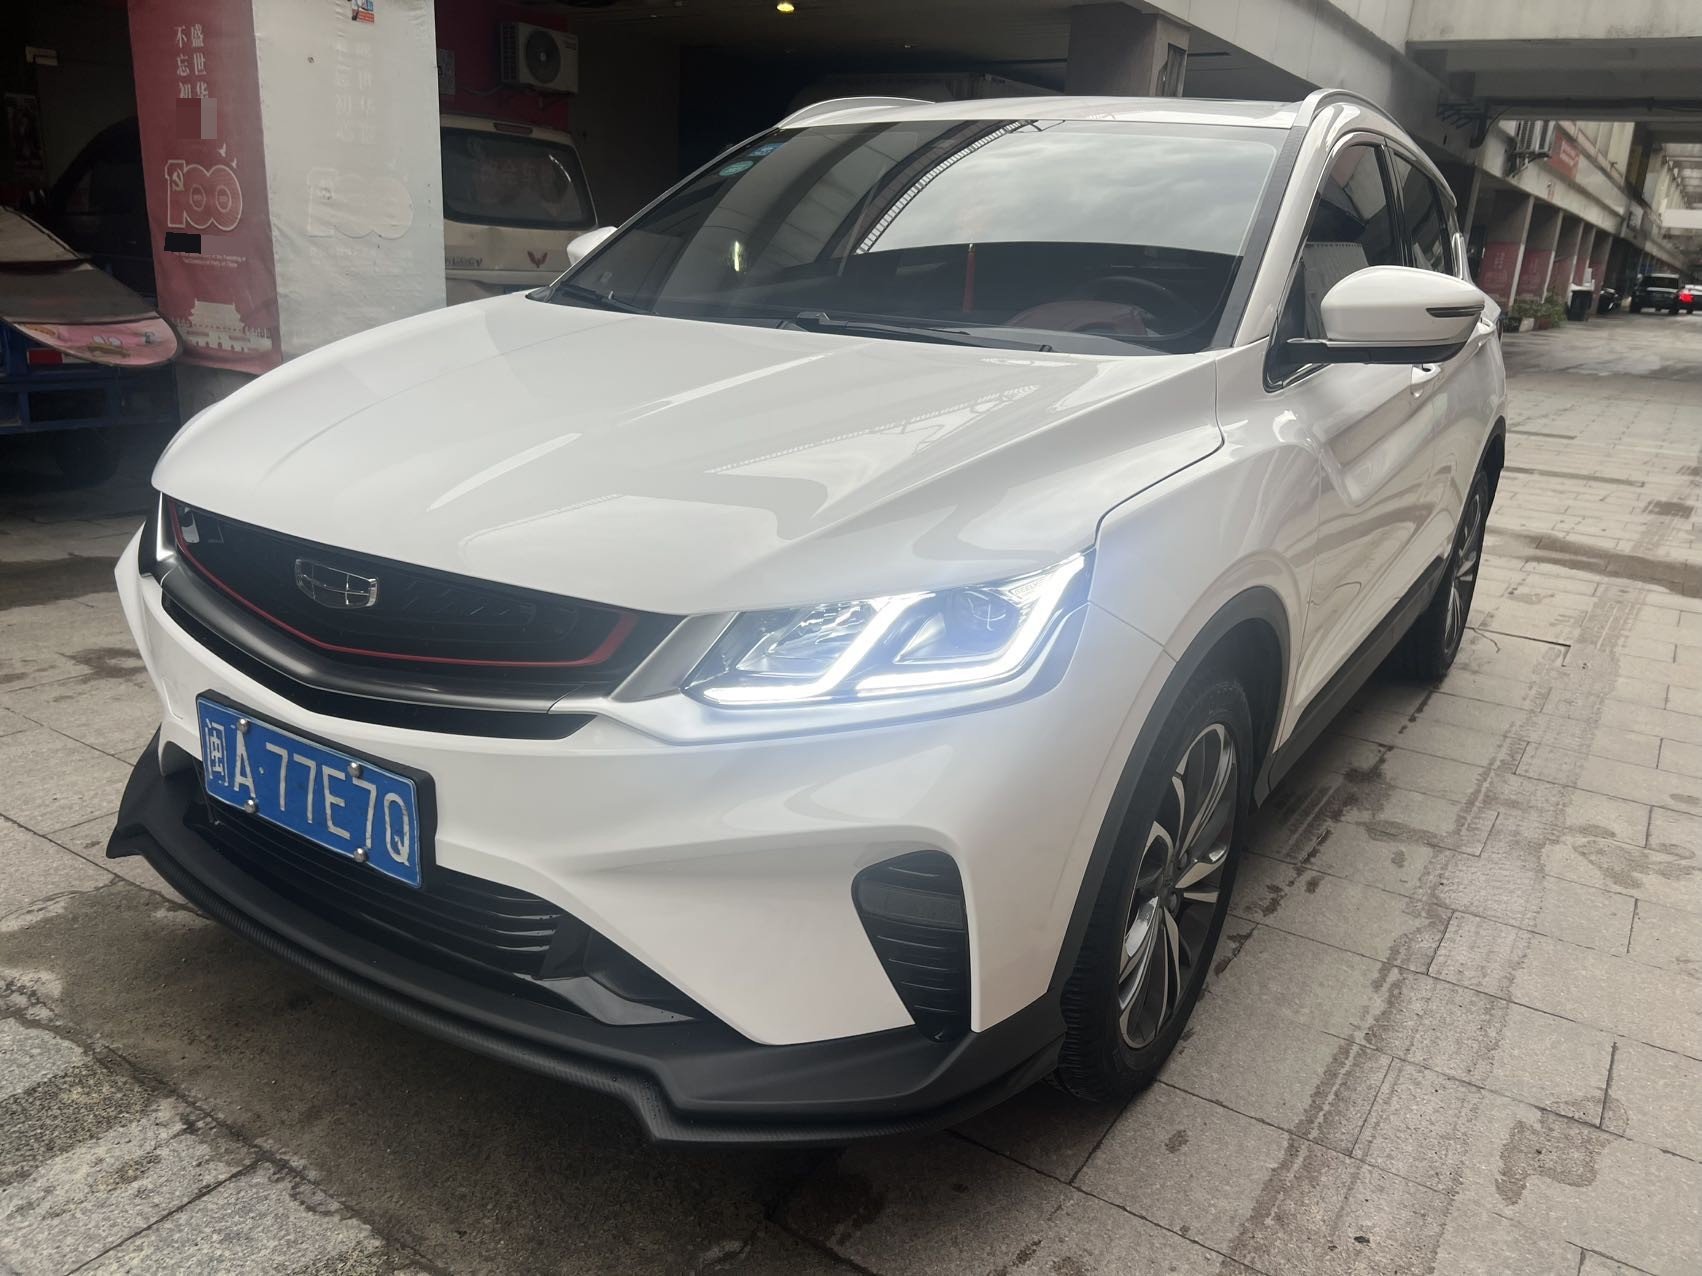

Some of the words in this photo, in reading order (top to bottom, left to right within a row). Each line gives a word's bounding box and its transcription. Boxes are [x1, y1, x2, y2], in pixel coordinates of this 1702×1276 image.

[174, 25, 192, 99] 不忘初
[191, 24, 209, 99] 盛世华
[165, 160, 242, 231] 100
